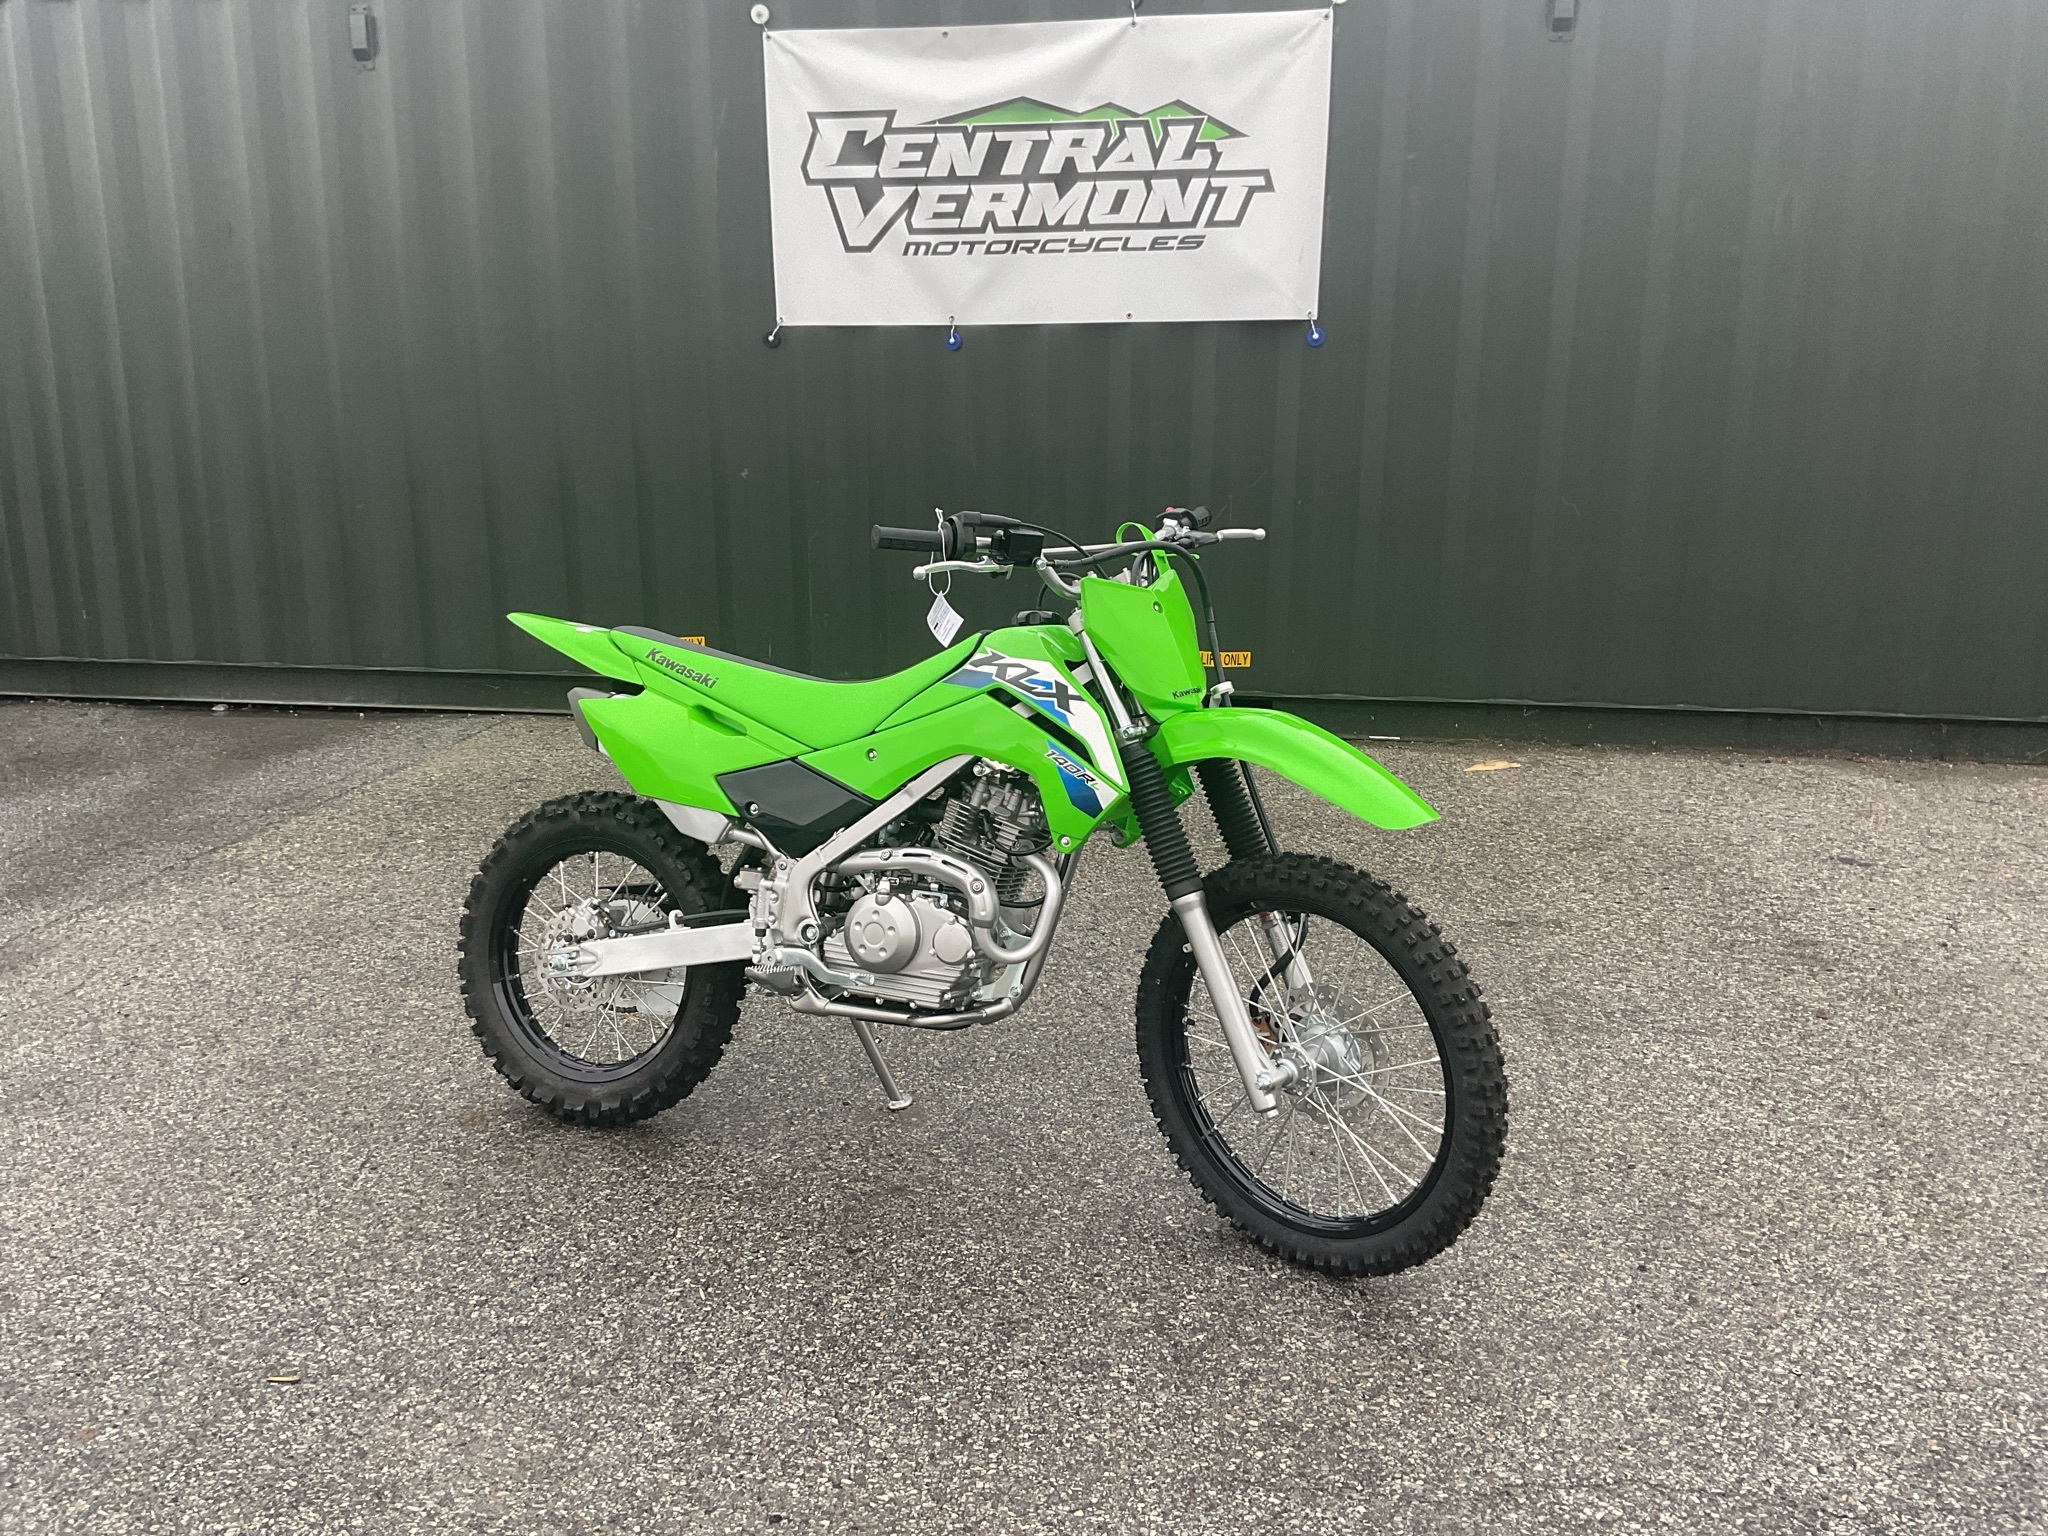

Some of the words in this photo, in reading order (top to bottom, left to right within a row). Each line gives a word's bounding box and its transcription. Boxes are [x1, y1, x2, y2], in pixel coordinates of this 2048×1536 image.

[803, 111, 1214, 181] CENTRAL
[826, 170, 1272, 252] VERMONT
[902, 234, 1206, 256] MOTORCYCLES
[645, 647, 719, 689] Kawasaki
[1201, 653, 1222, 666] LIF
[1223, 653, 1249, 666] ONLY
[968, 650, 1087, 716] KLX
[1171, 685, 1203, 699] Kawasa
